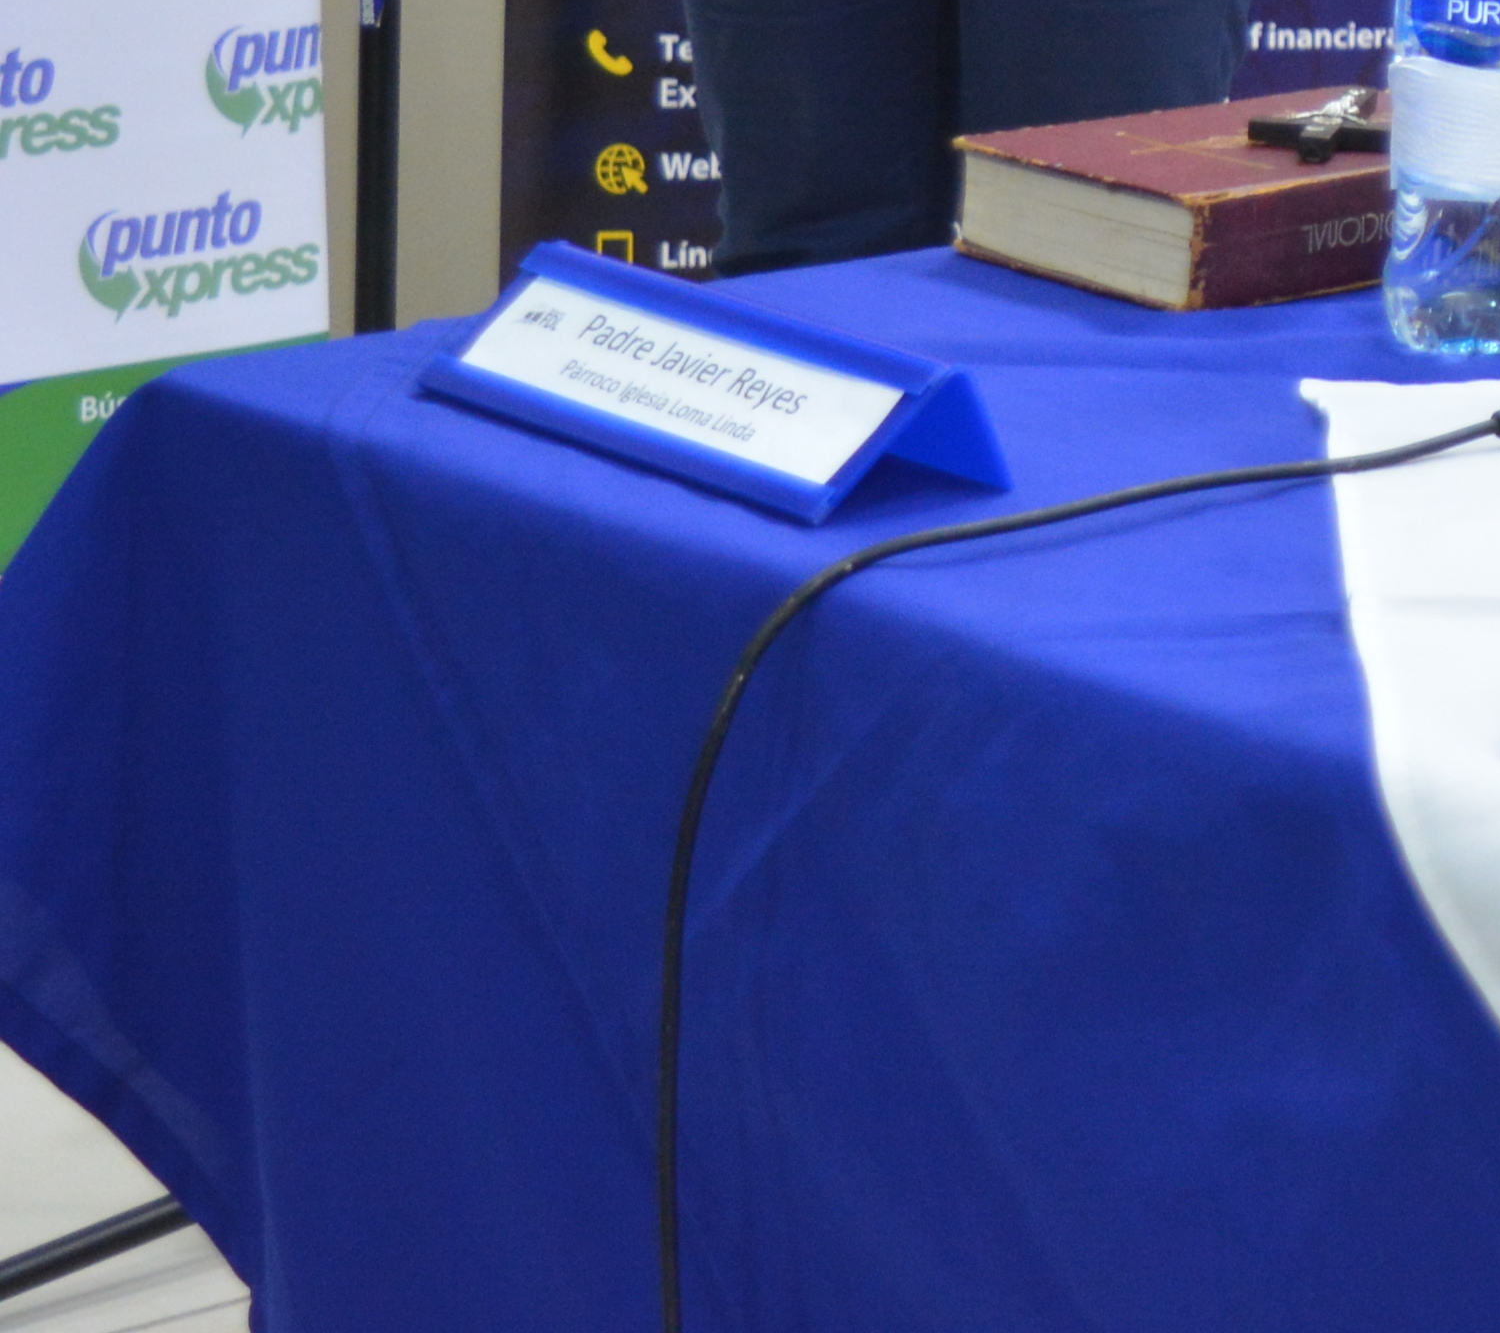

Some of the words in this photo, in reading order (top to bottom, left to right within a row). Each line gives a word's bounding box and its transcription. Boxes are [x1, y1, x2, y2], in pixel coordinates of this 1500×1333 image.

[659, 77, 697, 109] Ex
[102, 191, 262, 276] punto
[661, 239, 713, 270] Lín
[136, 242, 320, 318] xpress
[560, 358, 621, 396] Párroco
[618, 379, 669, 413] Iglesia
[668, 396, 712, 426] Loma
[711, 410, 758, 444] Linda
[577, 313, 656, 363] Padre
[650, 348, 732, 388] Javier
[727, 366, 808, 416] Reyes
